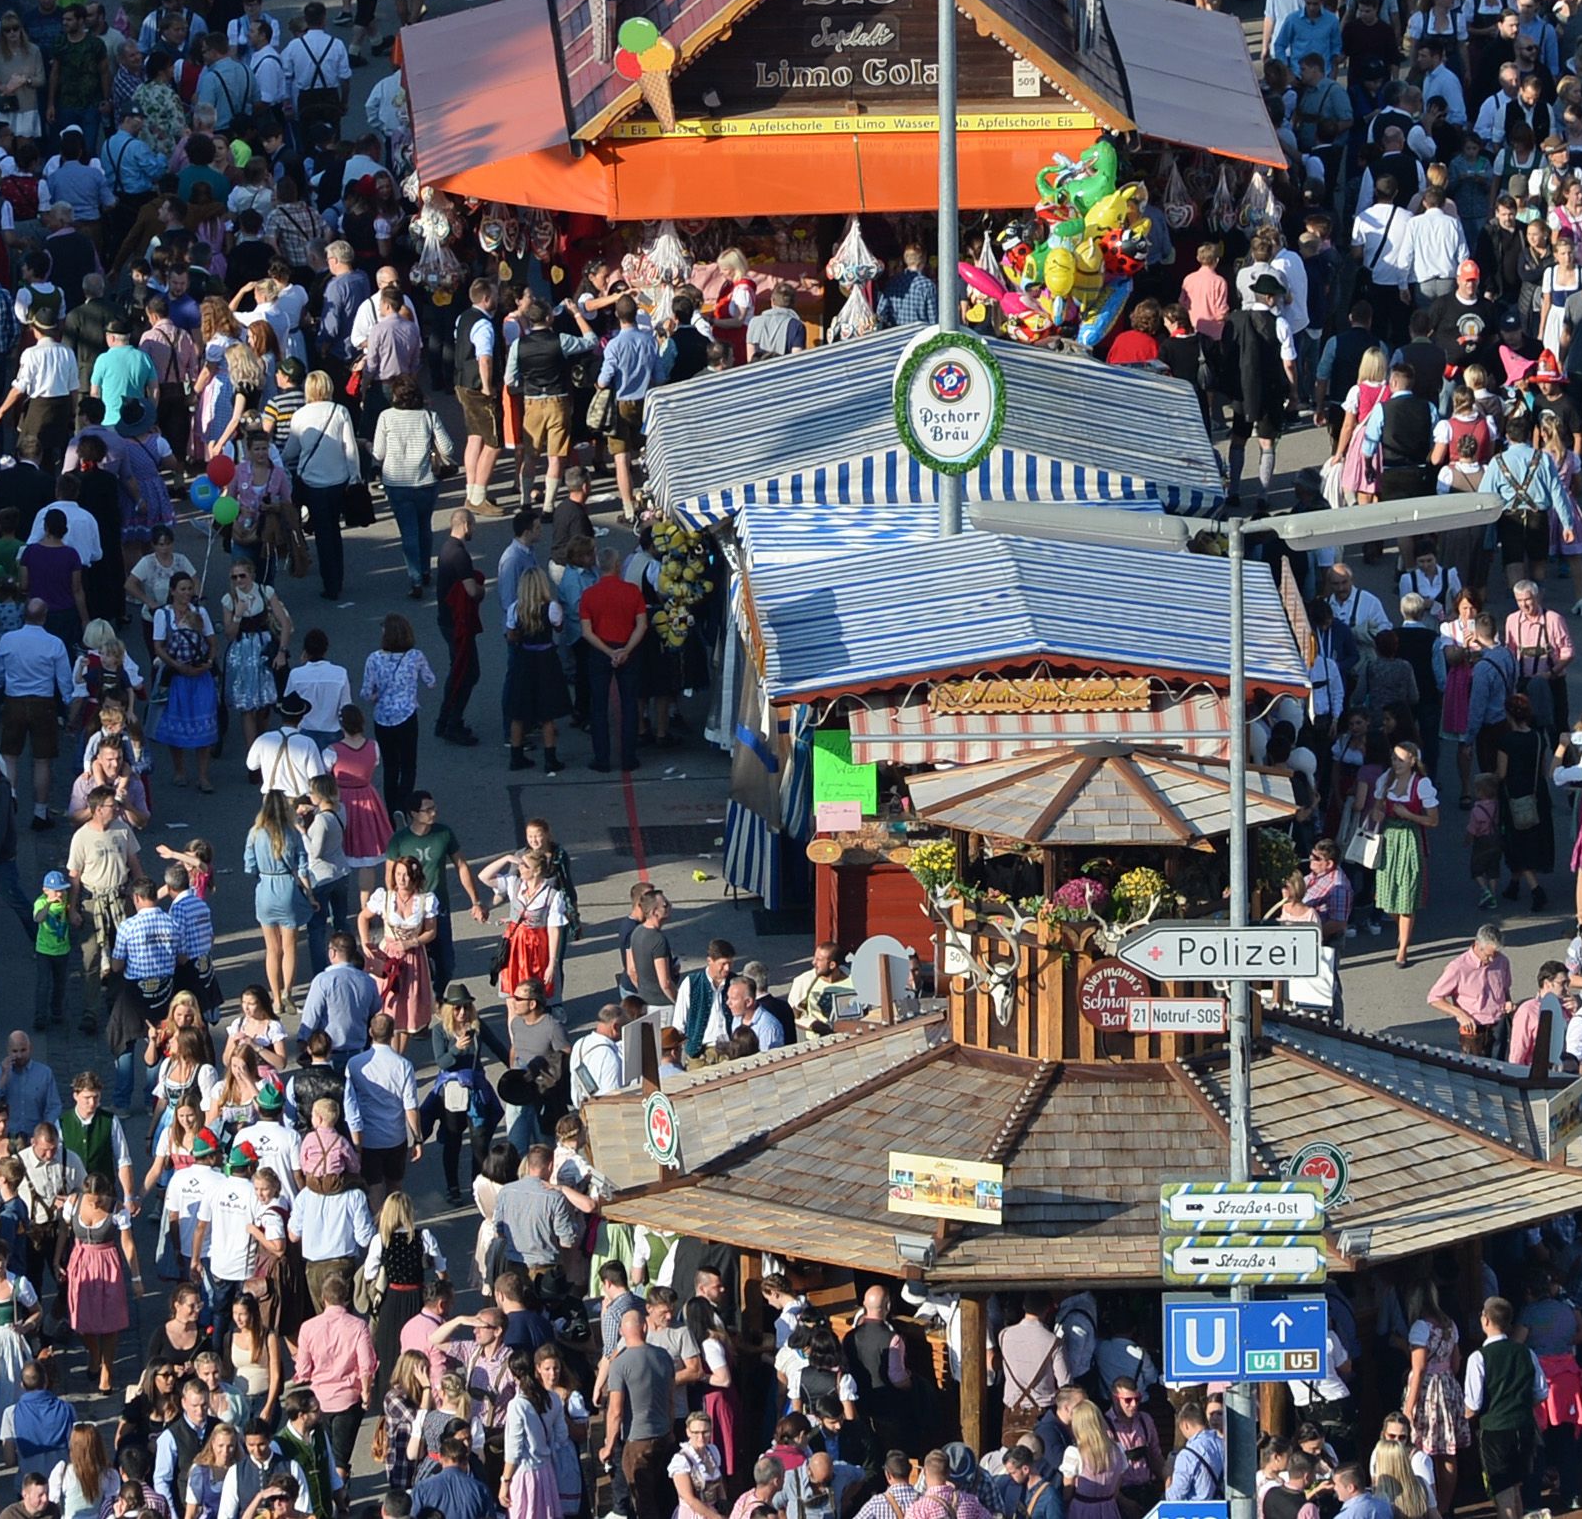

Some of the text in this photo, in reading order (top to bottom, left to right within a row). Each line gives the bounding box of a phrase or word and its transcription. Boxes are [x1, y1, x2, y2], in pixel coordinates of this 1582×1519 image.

[756, 58, 939, 87] Limo Cola
[1018, 75, 1036, 86] 509
[630, 125, 647, 135] Eis
[658, 125, 701, 134] Wsser
[712, 123, 738, 133] Cola
[749, 120, 823, 134] Apfelschorle
[834, 120, 850, 130] Eis
[856, 118, 886, 129] Limo
[894, 117, 935, 128] Wasser
[977, 117, 1051, 131] Apfelschorle
[1058, 116, 1073, 127] Eis
[919, 407, 980, 427] Pschorr
[930, 425, 969, 442] Bräu
[1178, 937, 1298, 966] Polizei
[1101, 1012, 1127, 1026] Bar
[1133, 1008, 1220, 1024] 21 Notruf-SOS
[1214, 1200, 1298, 1216] Straße 4-Ost
[1216, 1254, 1276, 1269] Straße 4
[1186, 1318, 1225, 1366] U
[1253, 1352, 1313, 1369] U4 U5
